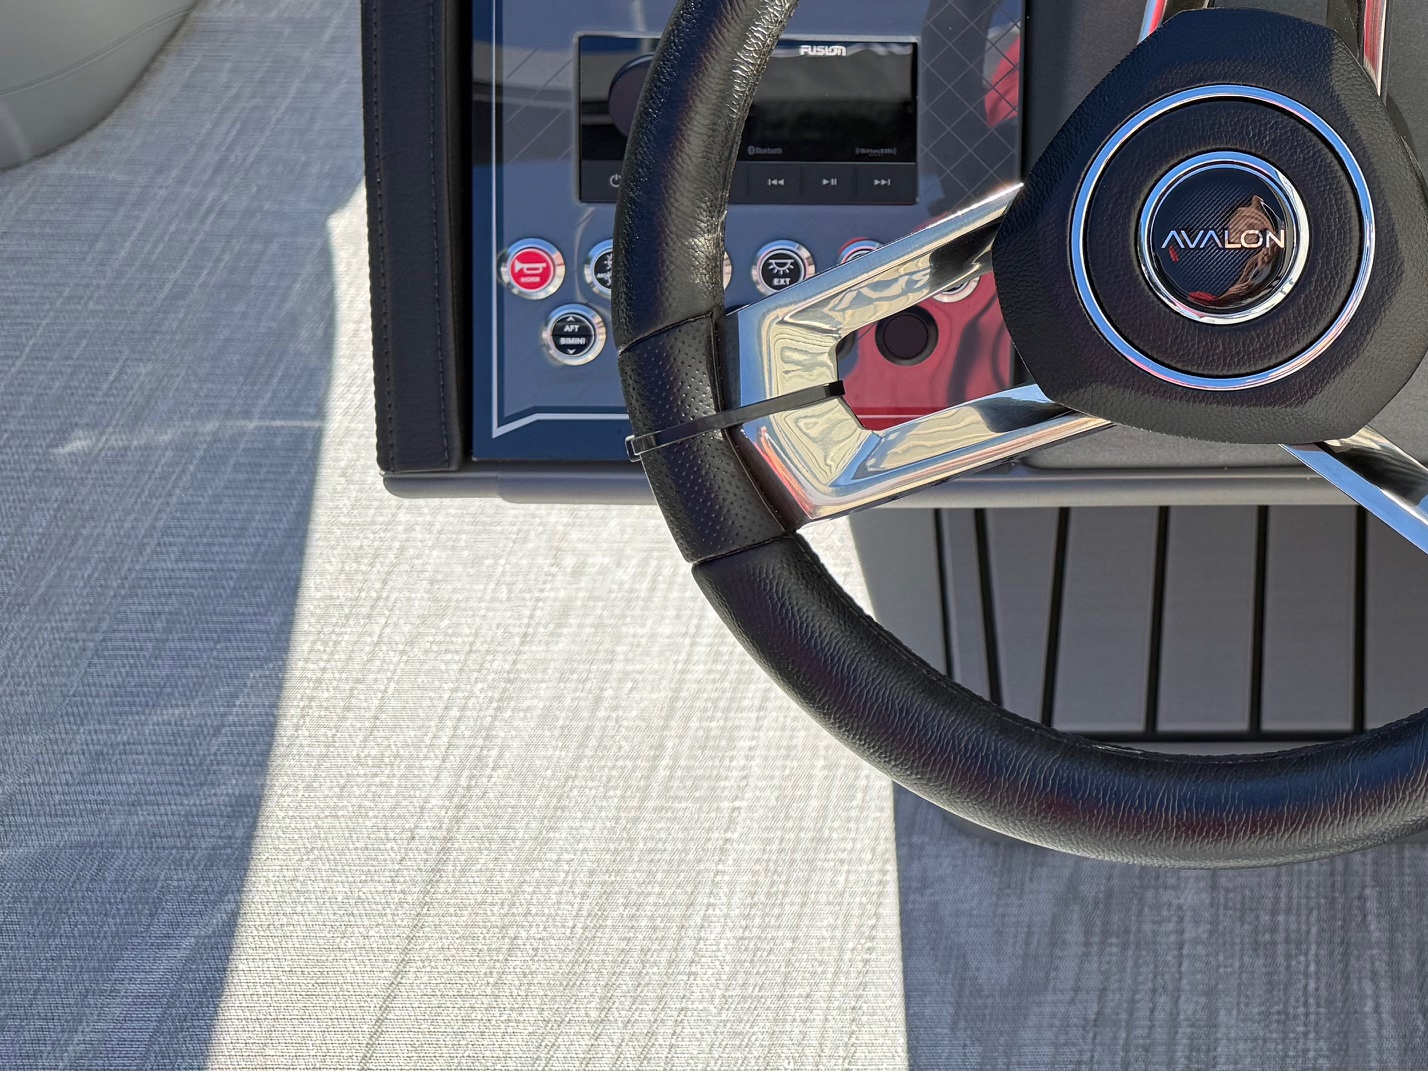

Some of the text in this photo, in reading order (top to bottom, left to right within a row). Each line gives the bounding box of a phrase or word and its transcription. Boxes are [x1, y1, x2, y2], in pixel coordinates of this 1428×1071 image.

[799, 44, 847, 57] FUSION
[755, 146, 784, 155] Bluetooth
[1160, 229, 1285, 249] AVALON
[772, 277, 792, 286] EXT
[563, 324, 580, 333] AFT
[559, 337, 587, 346] BIMINI
